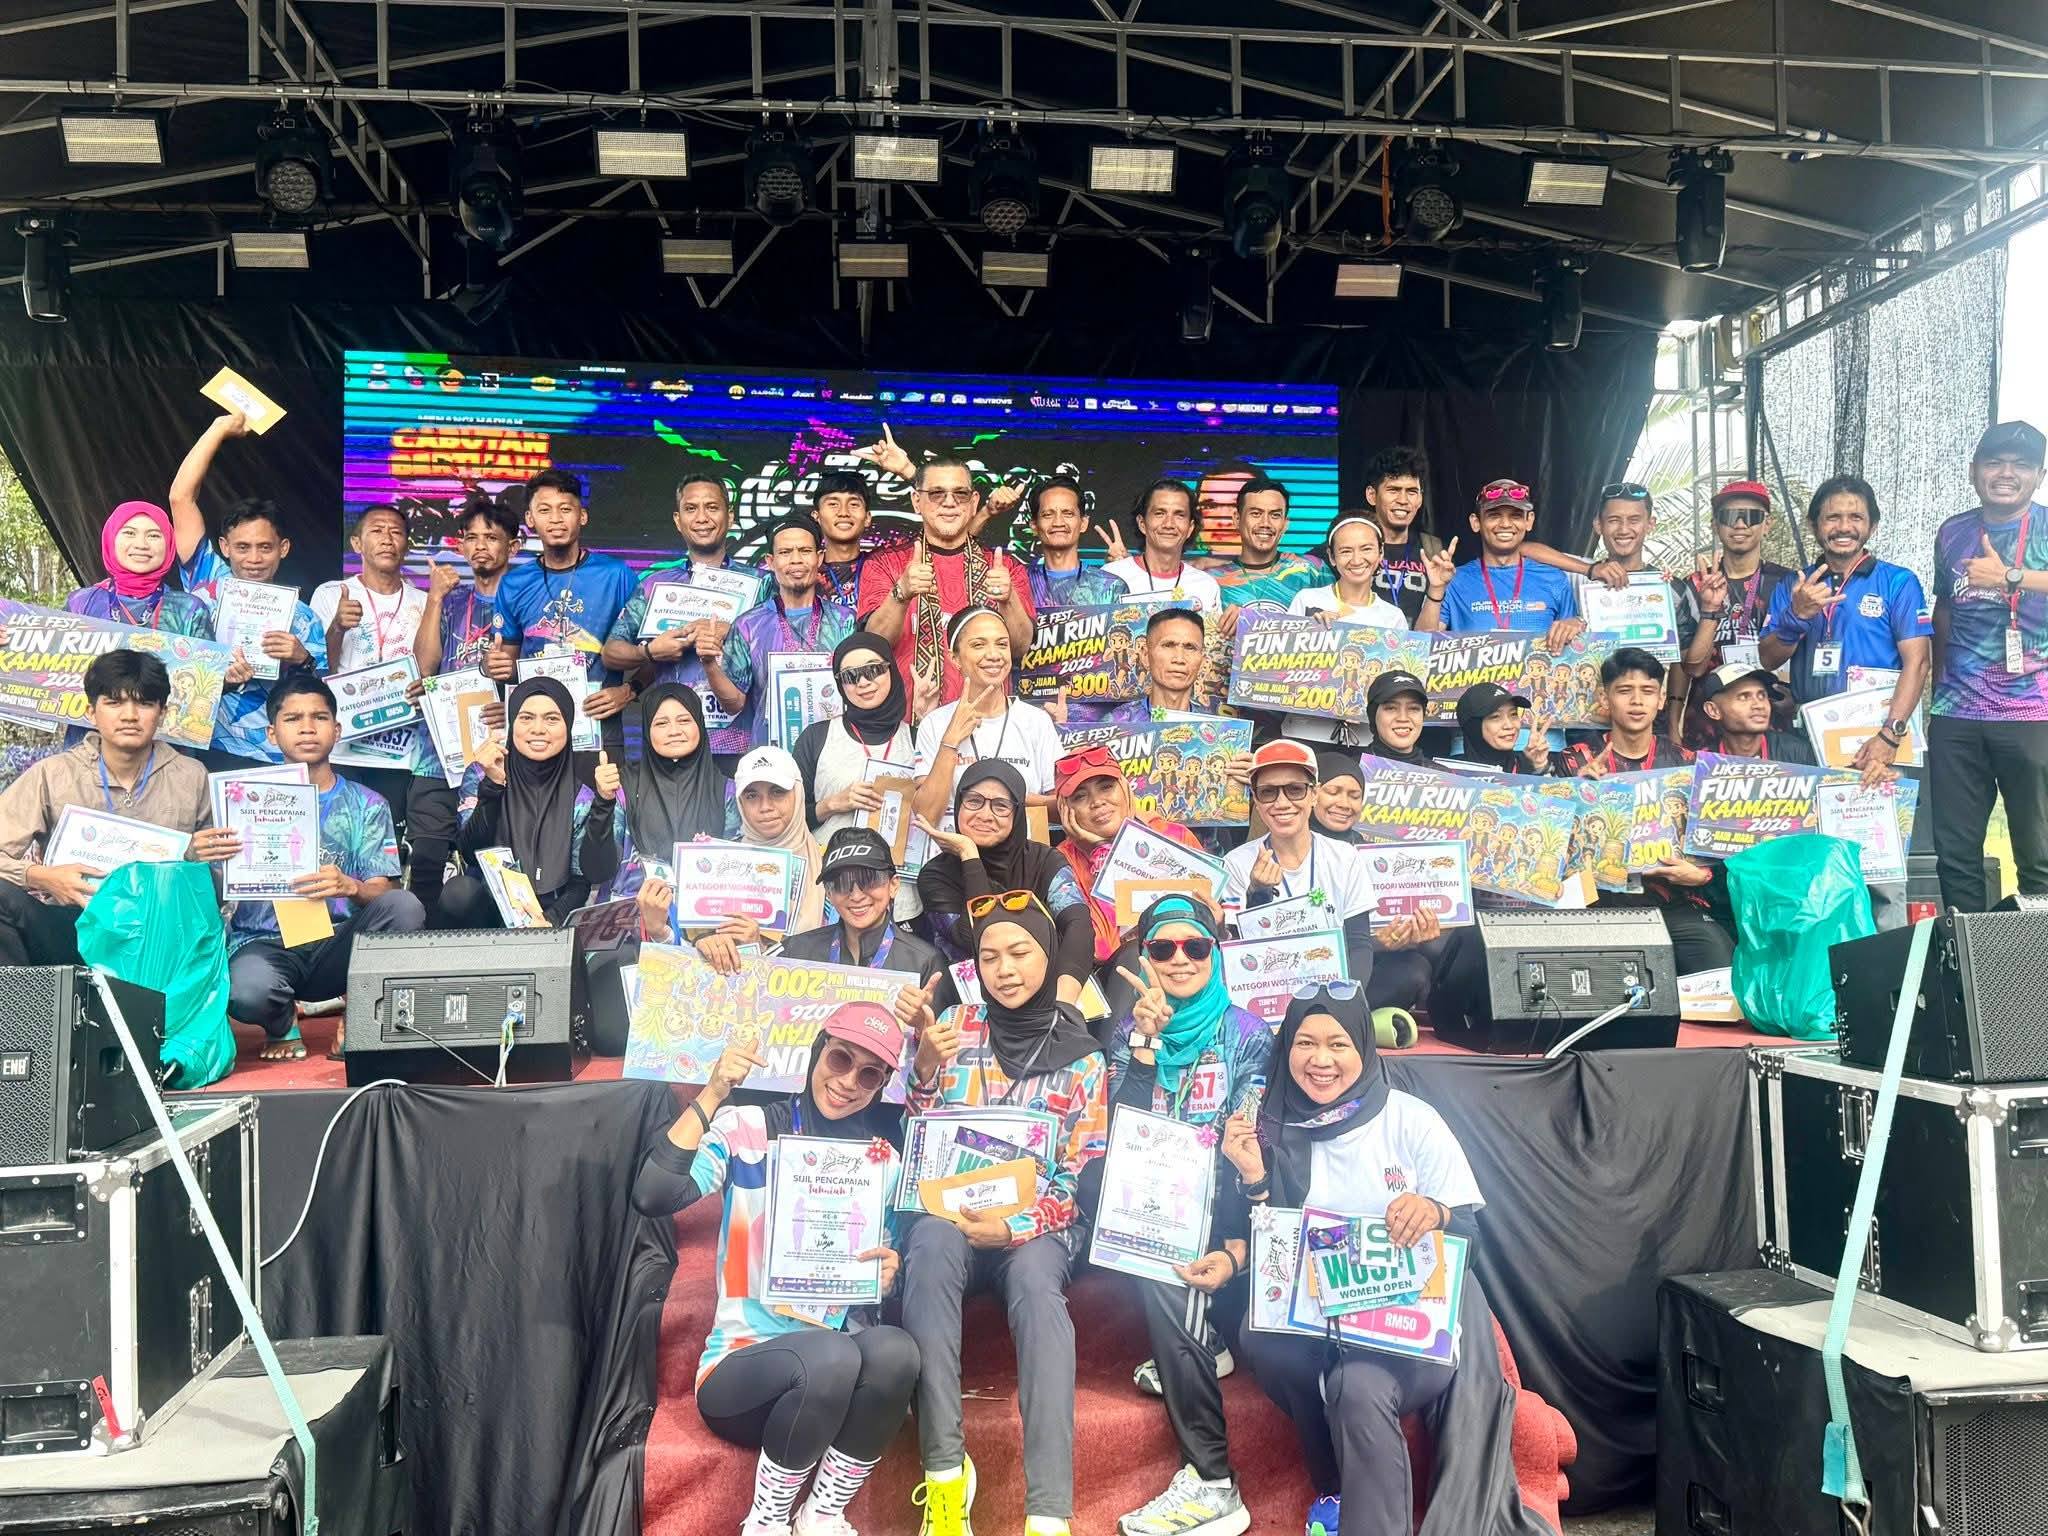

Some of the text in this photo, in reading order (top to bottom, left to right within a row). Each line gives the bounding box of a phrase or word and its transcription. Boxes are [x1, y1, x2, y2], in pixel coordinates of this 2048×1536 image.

[392, 428, 550, 453] CABUTAN
[8, 614, 81, 629] LIKE FEST
[1050, 610, 1074, 622] FEST
[1252, 620, 1310, 630] LIKE FEST
[1031, 614, 1108, 650] UN RUN
[60, 631, 124, 655] RUN
[1241, 630, 1344, 656] FUN RUN
[1433, 635, 1489, 651] LIKE FEST
[0, 649, 97, 673] KAAMAT
[1021, 636, 1106, 671] KAAMATAN
[1242, 652, 1339, 672] KAAMATAN
[1425, 640, 1526, 673] FUN RUN
[1822, 651, 1833, 666] 5
[1059, 656, 1094, 675] 2026
[1072, 672, 1108, 698] 300
[1283, 670, 1321, 683] 2026
[1427, 662, 1523, 693] KAAMATAN
[57, 691, 88, 719] 10
[340, 699, 372, 712] KATEGORI
[1295, 686, 1337, 710] 200
[1060, 726, 1118, 745] LIKE FEST
[376, 741, 404, 752] VETERAN
[1374, 768, 1436, 784] LIKE FEST
[1712, 764, 1778, 777] LIKE FEST
[1363, 782, 1475, 811] FUN RUN
[1700, 775, 1815, 803] FUN RUN
[259, 808, 306, 816] PENCAPAIAN
[1360, 804, 1468, 828] KAAMATAN
[1700, 799, 1810, 820] KAAMATAN
[1404, 826, 1448, 840] 2026
[1747, 818, 1792, 832] 2026
[1631, 839, 1671, 866] 300
[1114, 859, 1149, 880] KATEGORI
[760, 887, 782, 895] OPEN
[1373, 880, 1460, 891] TEGORI WOMEN VETERAN
[768, 966, 828, 998] 200
[1231, 981, 1271, 992] KATEGORI
[766, 1047, 811, 1078] UN
[793, 1175, 870, 1187] SIJIL PENCAPAIAN
[1366, 1222, 1392, 1263] 10
[1339, 1279, 1413, 1299] WOMEN OPEN
[1384, 1311, 1418, 1332] RM50
